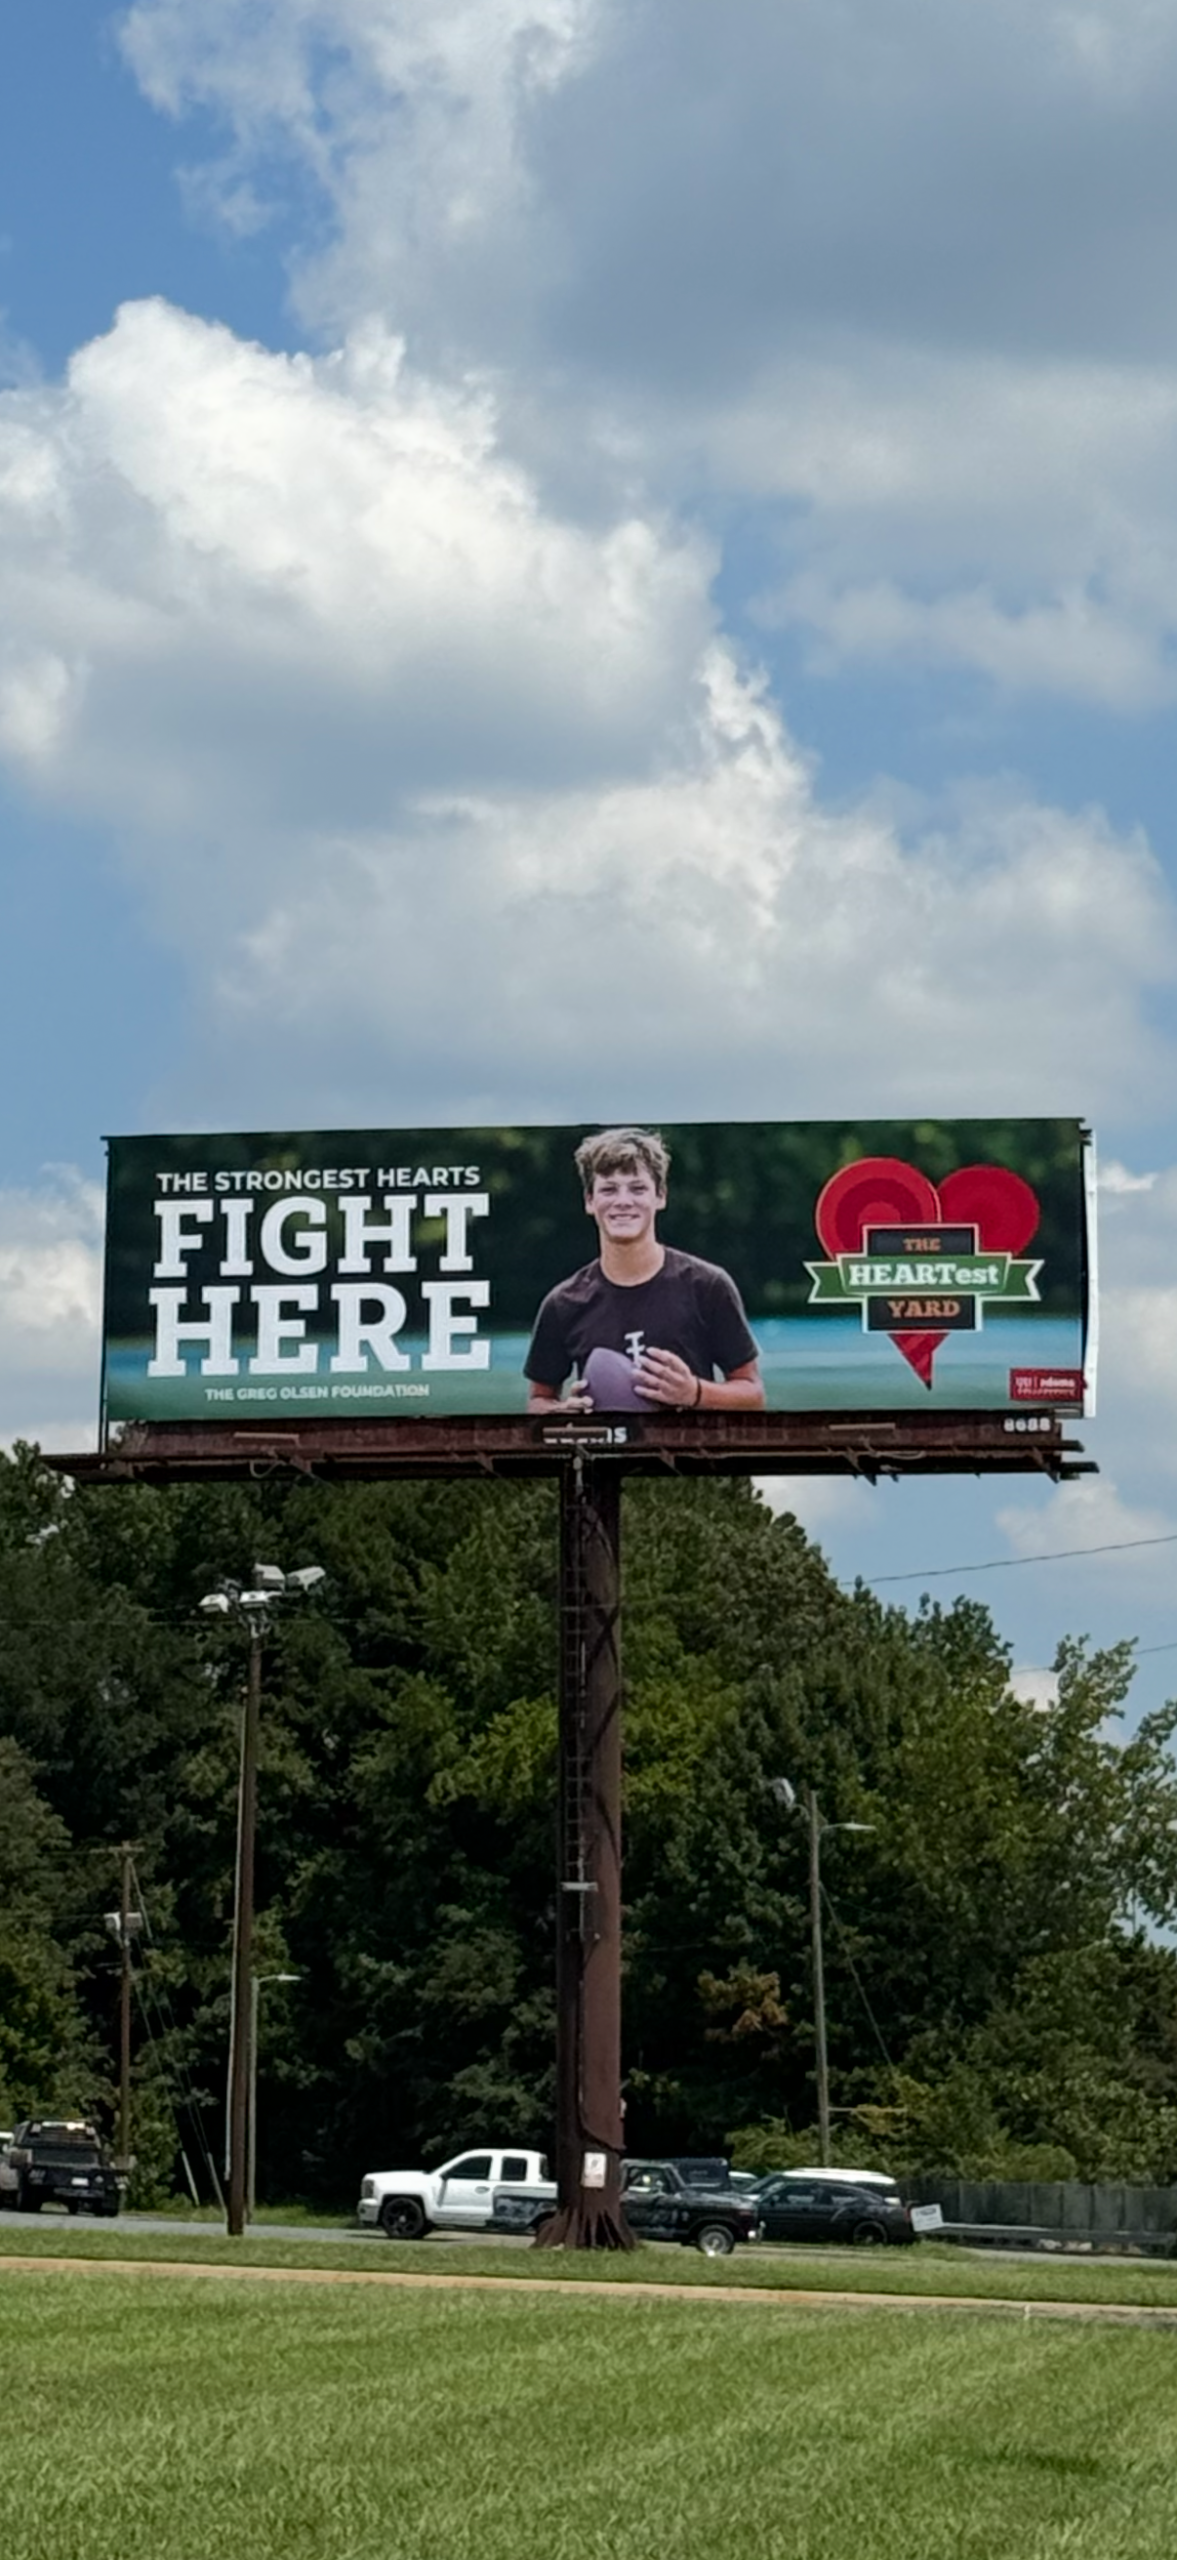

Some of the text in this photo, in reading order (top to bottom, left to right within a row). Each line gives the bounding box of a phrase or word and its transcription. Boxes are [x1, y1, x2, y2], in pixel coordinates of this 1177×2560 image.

[156, 1166, 481, 1192] THE STRONGEST HEARTS
[153, 1193, 490, 1279] FIGHT
[903, 1237, 941, 1251] THE
[848, 1263, 1000, 1286] HEARTest
[887, 1300, 960, 1318] YARD
[147, 1280, 491, 1378] HERE
[205, 1384, 430, 1401] THE GREG OLSEN FOUNDATION
